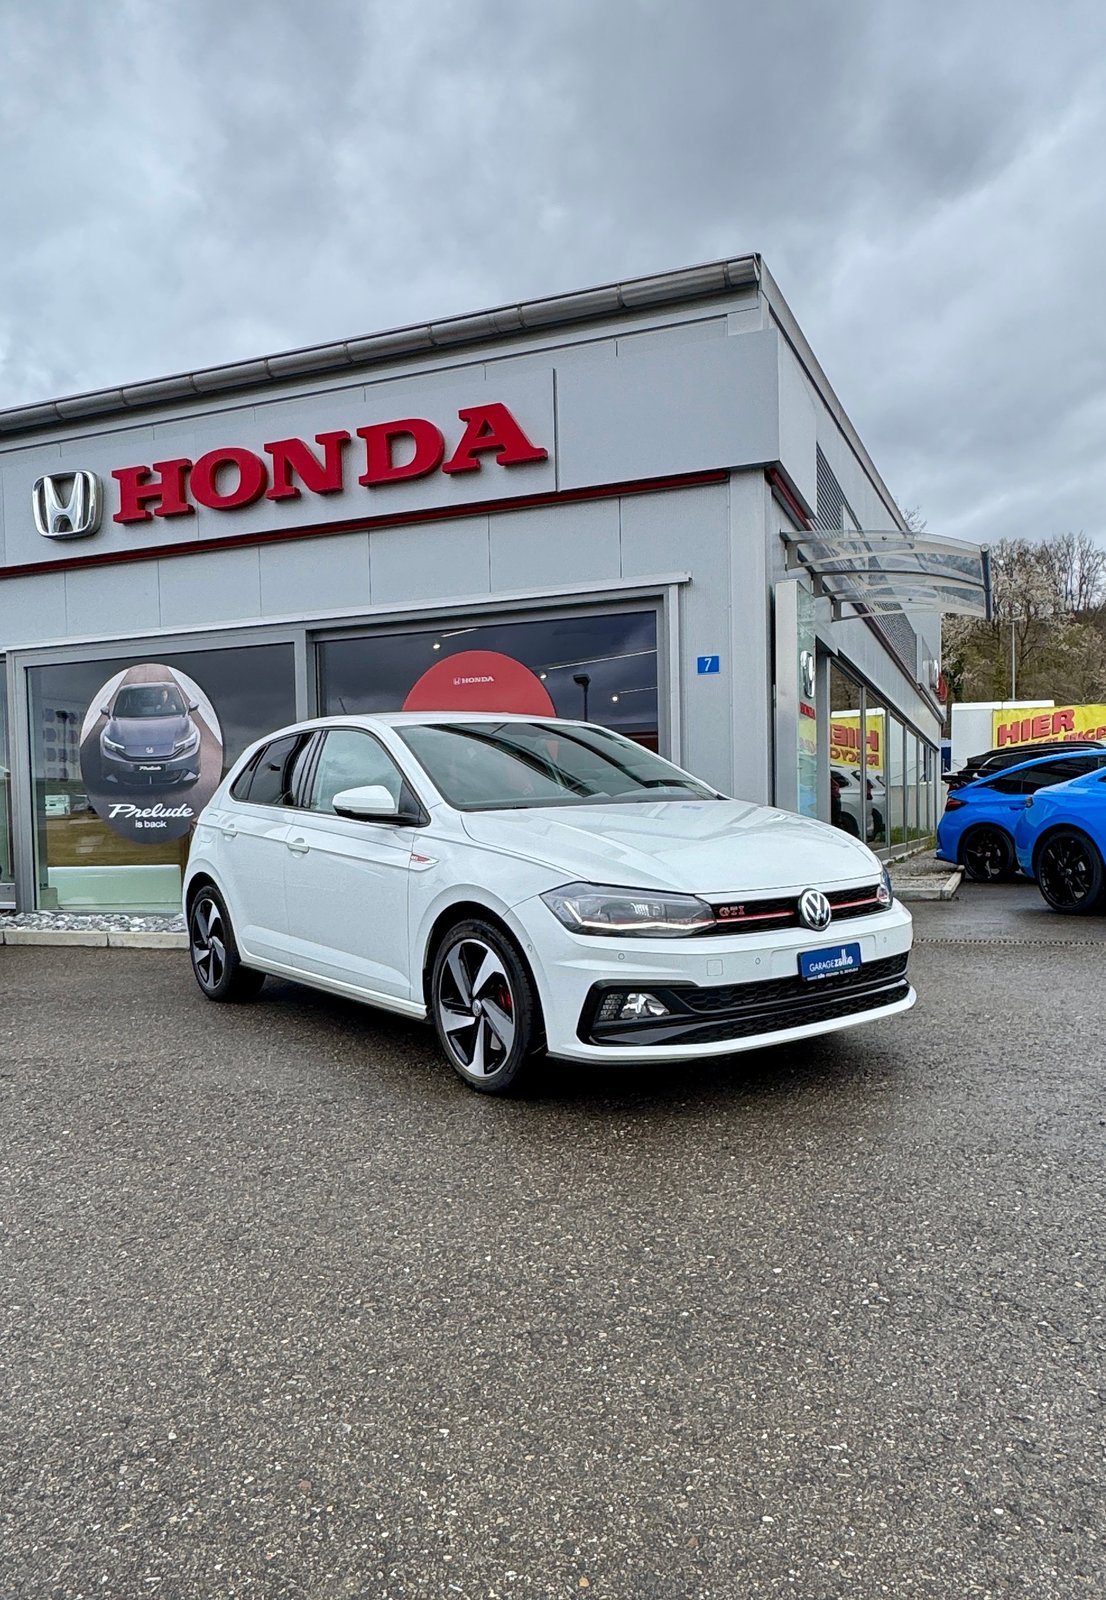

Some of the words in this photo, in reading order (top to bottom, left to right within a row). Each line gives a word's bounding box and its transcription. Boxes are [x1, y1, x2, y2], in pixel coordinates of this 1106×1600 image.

[111, 402, 548, 525] HONDA
[704, 657, 712, 672] 7
[461, 675, 495, 684] HONDA
[997, 708, 1075, 747] HIER
[108, 803, 194, 818] Prelude
[135, 820, 143, 828] is
[144, 820, 167, 828] back
[719, 905, 745, 917] GTI
